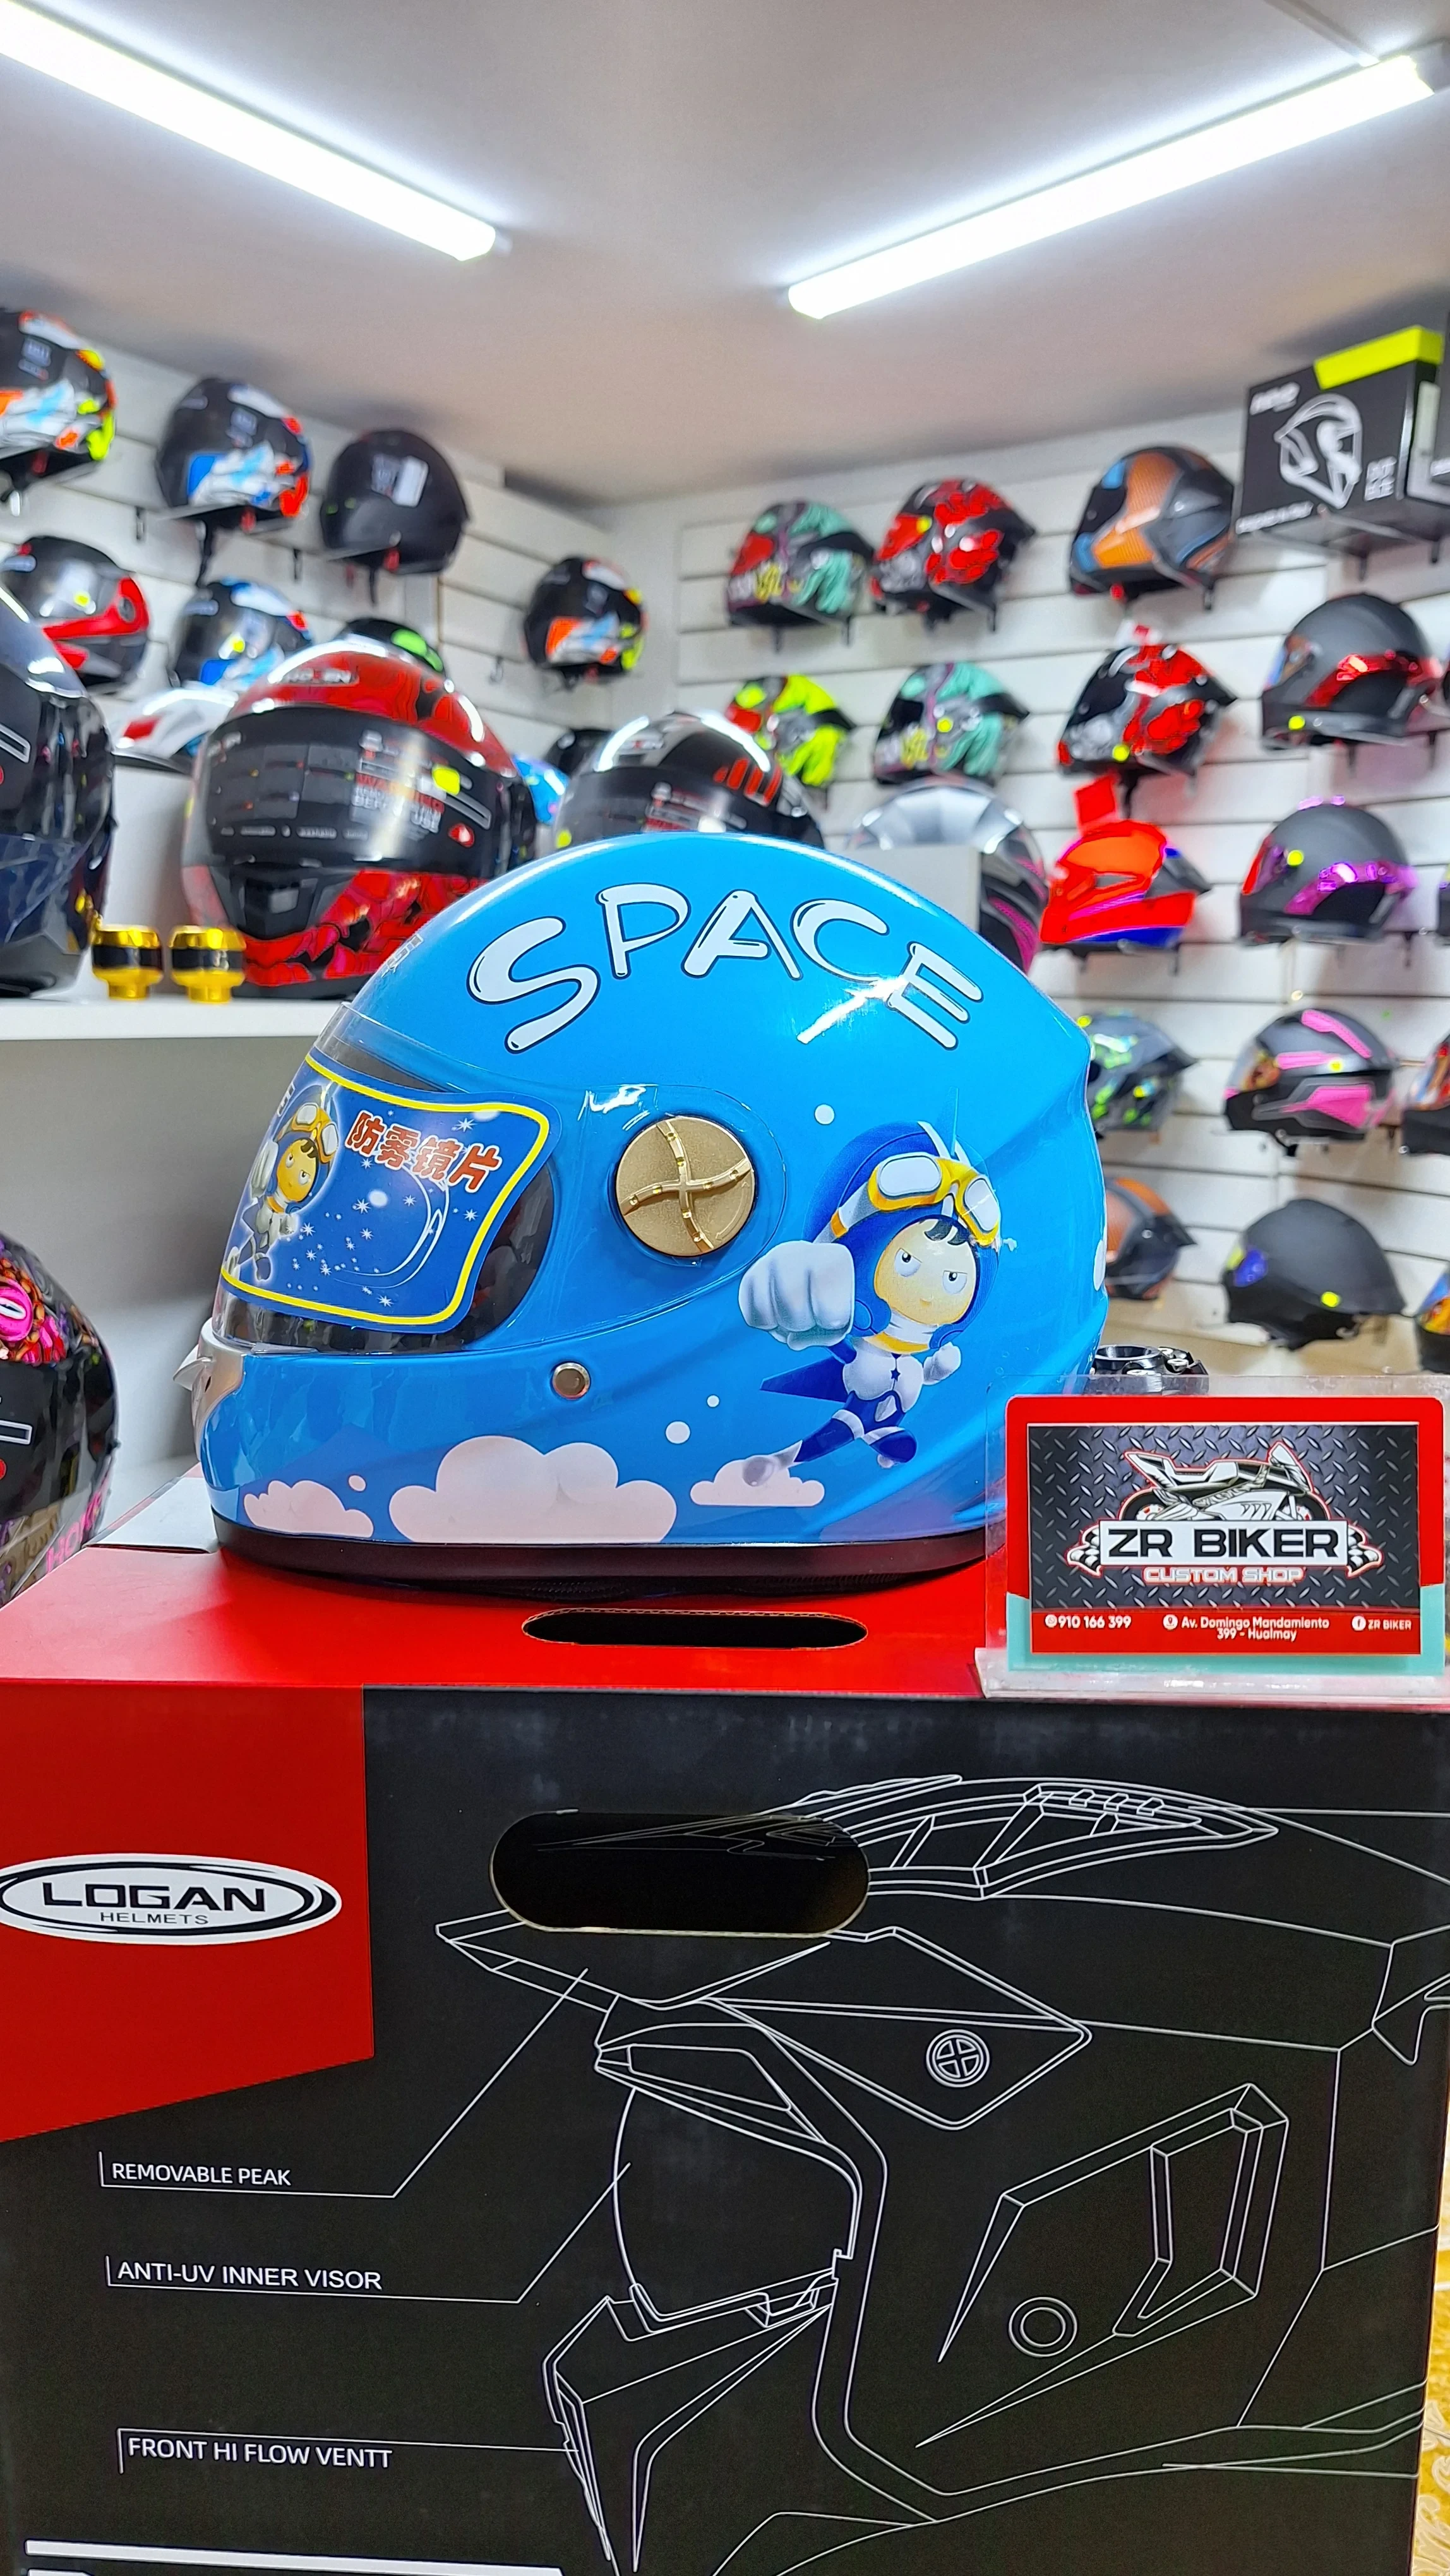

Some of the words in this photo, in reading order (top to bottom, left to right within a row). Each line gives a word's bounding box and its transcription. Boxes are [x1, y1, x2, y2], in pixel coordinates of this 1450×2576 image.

[466, 883, 983, 1053] SPACE
[1108, 1529, 1173, 1558] ZR
[1194, 1529, 1339, 1558] BIKER
[1144, 1566, 1238, 1582] CUSTOM
[1242, 1566, 1304, 1582] SHOP
[1057, 1615, 1080, 1629] 910
[1083, 1615, 1105, 1629] 166
[1108, 1615, 1132, 1629] 399
[1180, 1616, 1199, 1628] Av.
[1201, 1616, 1250, 1631] Domingo
[1252, 1616, 1330, 1629] Mandamiento
[1367, 1619, 1381, 1630] ZR
[1383, 1619, 1412, 1631] BIKER
[1216, 1628, 1237, 1641] 399
[1247, 1627, 1298, 1642] Hualmay
[42, 1881, 265, 1912] LOGAN
[100, 1911, 209, 1926] HELMETS
[111, 2162, 234, 2185] REMOVABLE
[237, 2167, 292, 2186] PEAK
[117, 2261, 215, 2284] ANTI-UV
[222, 2265, 299, 2287] INNER
[303, 2269, 383, 2291] VISOR
[127, 2436, 208, 2461] FRONT
[213, 2441, 238, 2462] HI
[244, 2443, 311, 2465] FLOW
[315, 2446, 393, 2469] VENTT
